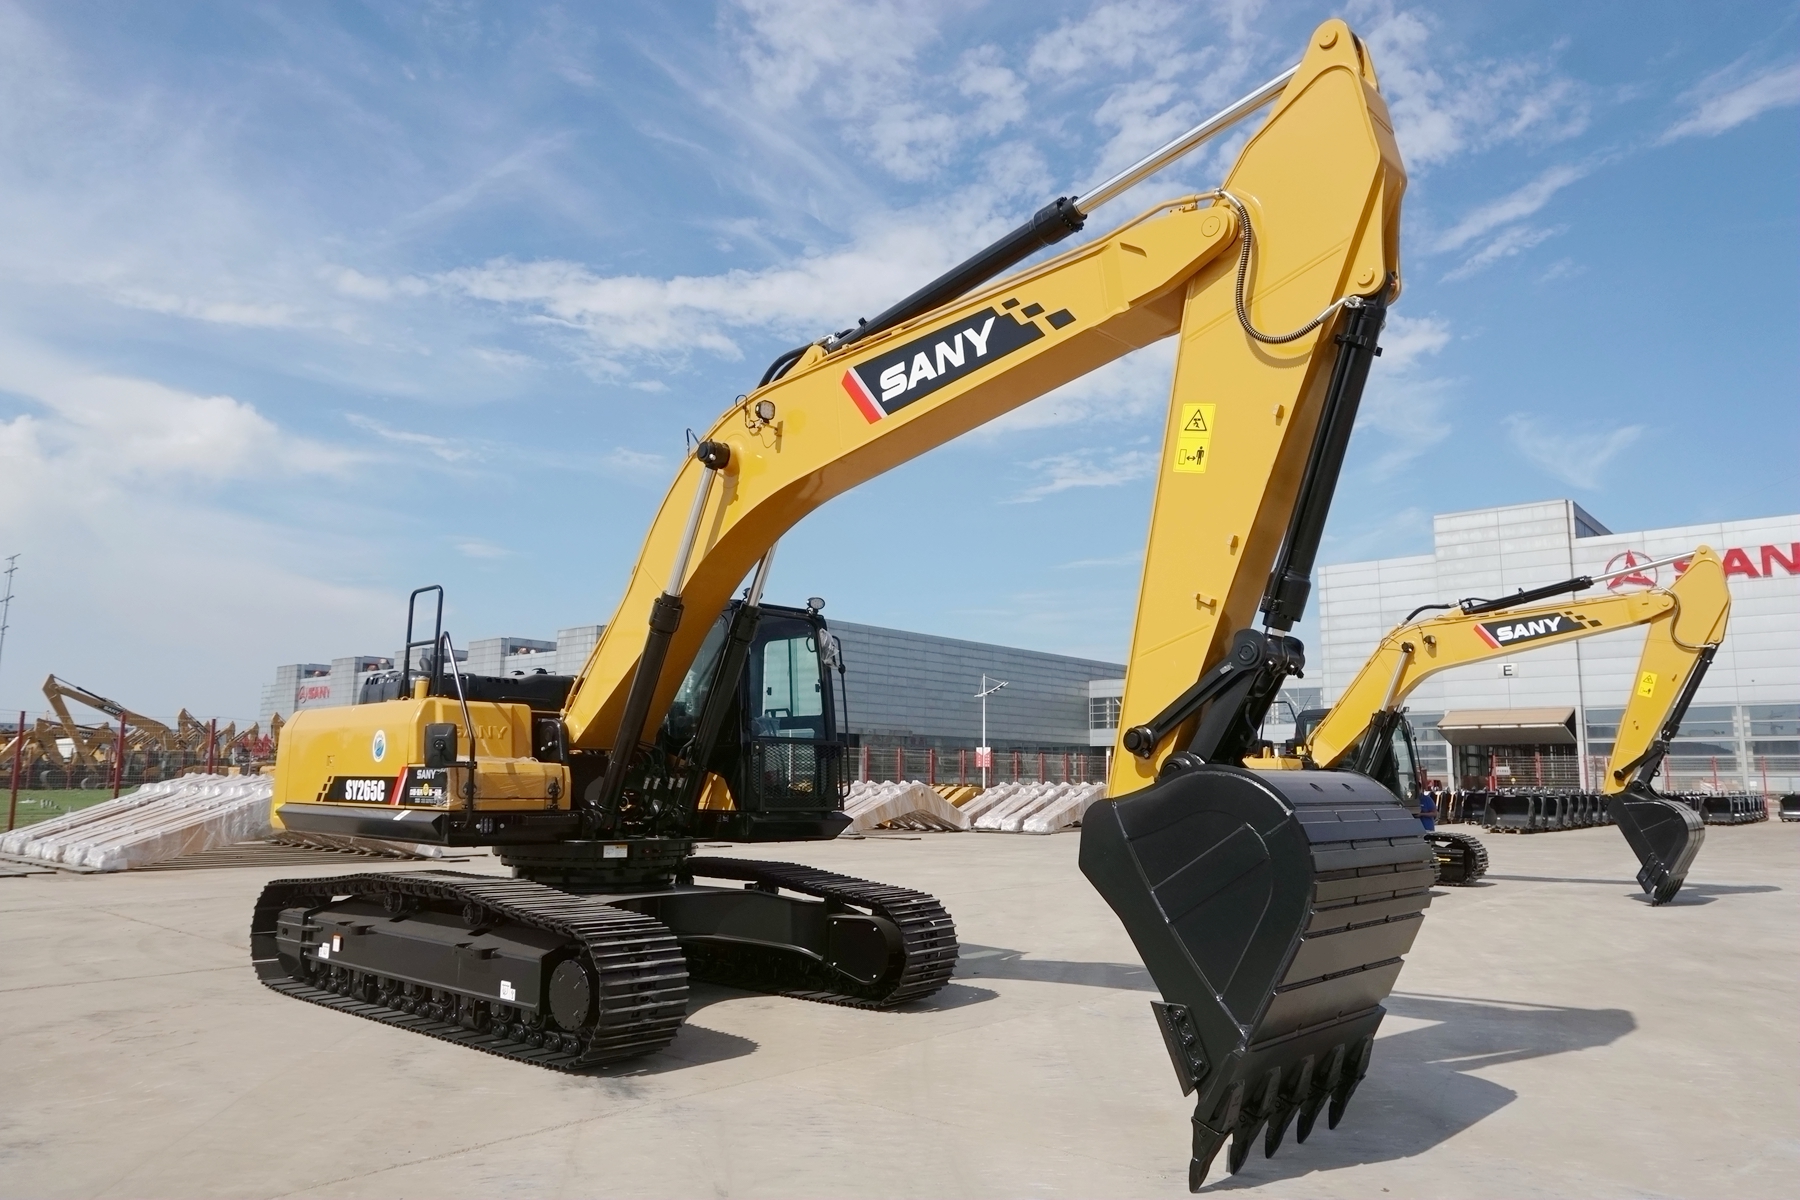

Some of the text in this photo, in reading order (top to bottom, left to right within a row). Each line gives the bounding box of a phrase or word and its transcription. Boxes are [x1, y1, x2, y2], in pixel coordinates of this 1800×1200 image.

[879, 316, 996, 402] SANY
[1496, 616, 1561, 642] SANY
[1503, 665, 1513, 676] E
[416, 769, 436, 780] SANY
[345, 779, 385, 801] SY265C
